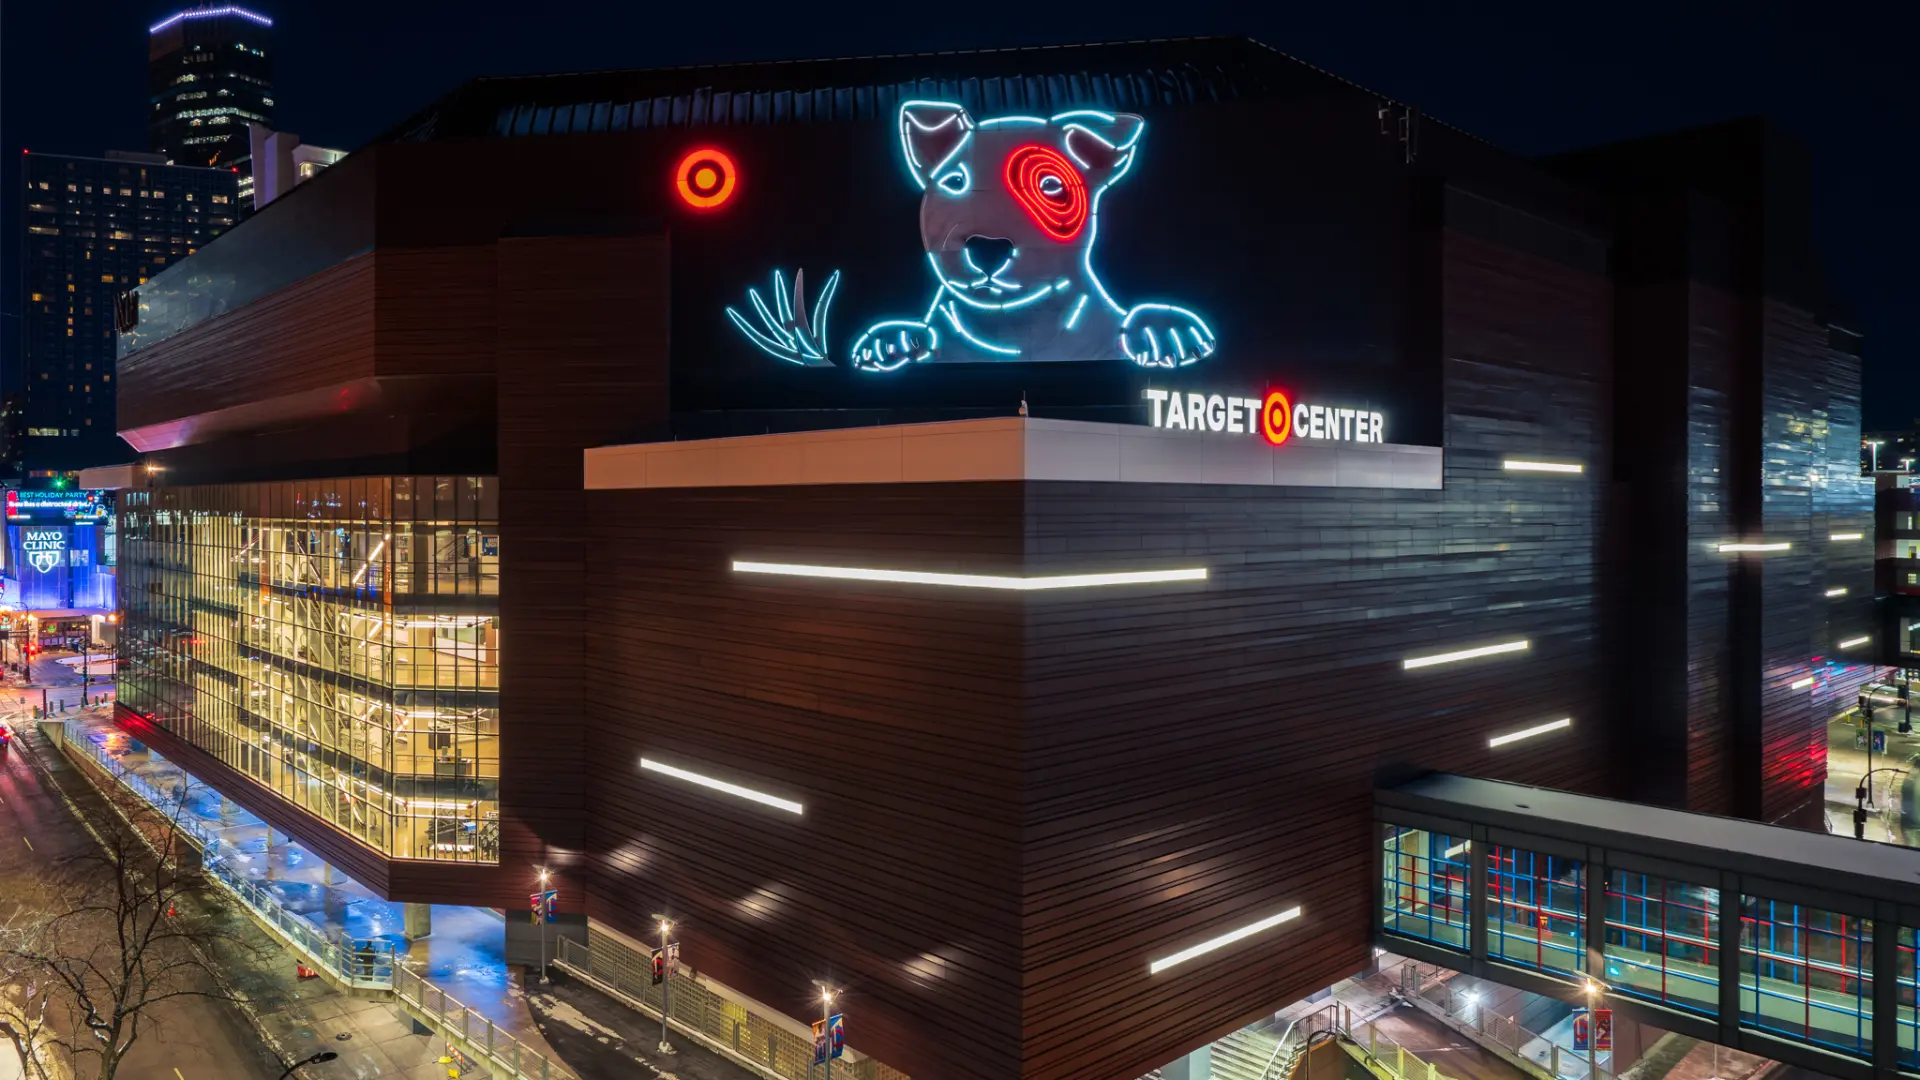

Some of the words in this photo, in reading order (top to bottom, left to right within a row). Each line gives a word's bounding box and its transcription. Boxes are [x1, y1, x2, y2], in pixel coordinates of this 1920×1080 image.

[1146, 388, 1262, 435] TARGET
[1292, 403, 1384, 444] CENTER
[26, 531, 62, 541] MAYO
[23, 541, 66, 550] CLINIC
